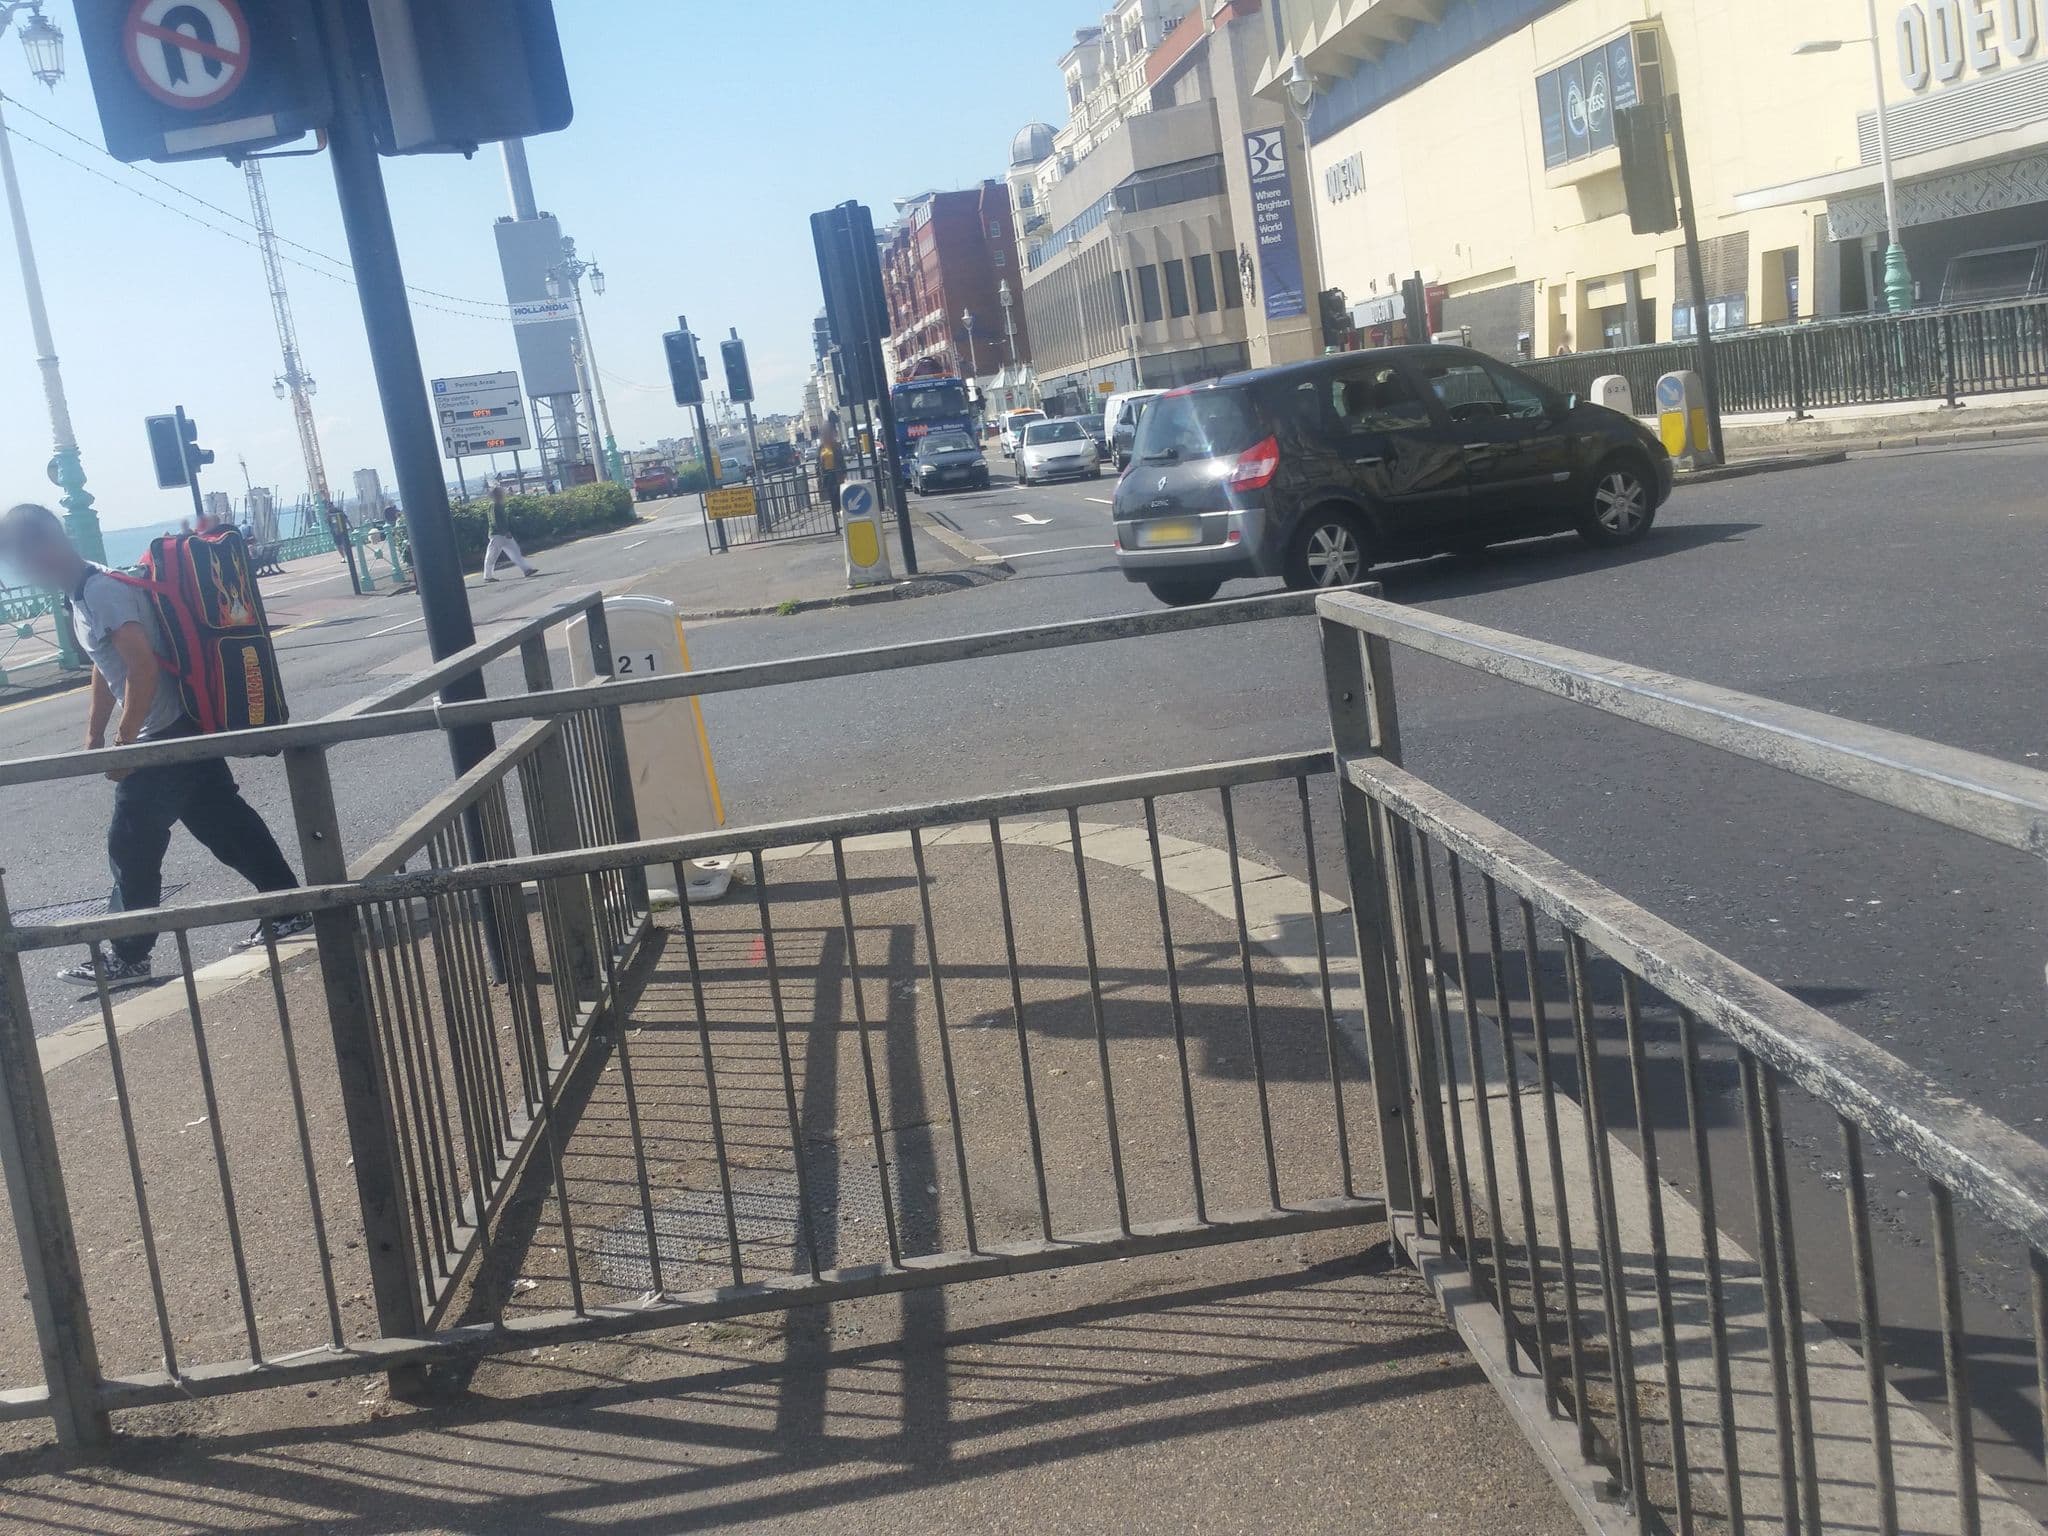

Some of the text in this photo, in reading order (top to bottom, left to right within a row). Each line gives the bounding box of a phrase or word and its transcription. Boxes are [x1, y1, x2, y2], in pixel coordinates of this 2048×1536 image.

[1896, 0, 2048, 92] ODEO
[1256, 189, 1281, 201] Where
[1257, 199, 1291, 213] Brighton
[1258, 212, 1280, 223] & the
[1259, 222, 1283, 234] World
[1261, 234, 1282, 245] Meet
[513, 303, 569, 317] HOLLANDIA
[472, 408, 492, 418] OPEN
[486, 439, 506, 448] OPEN
